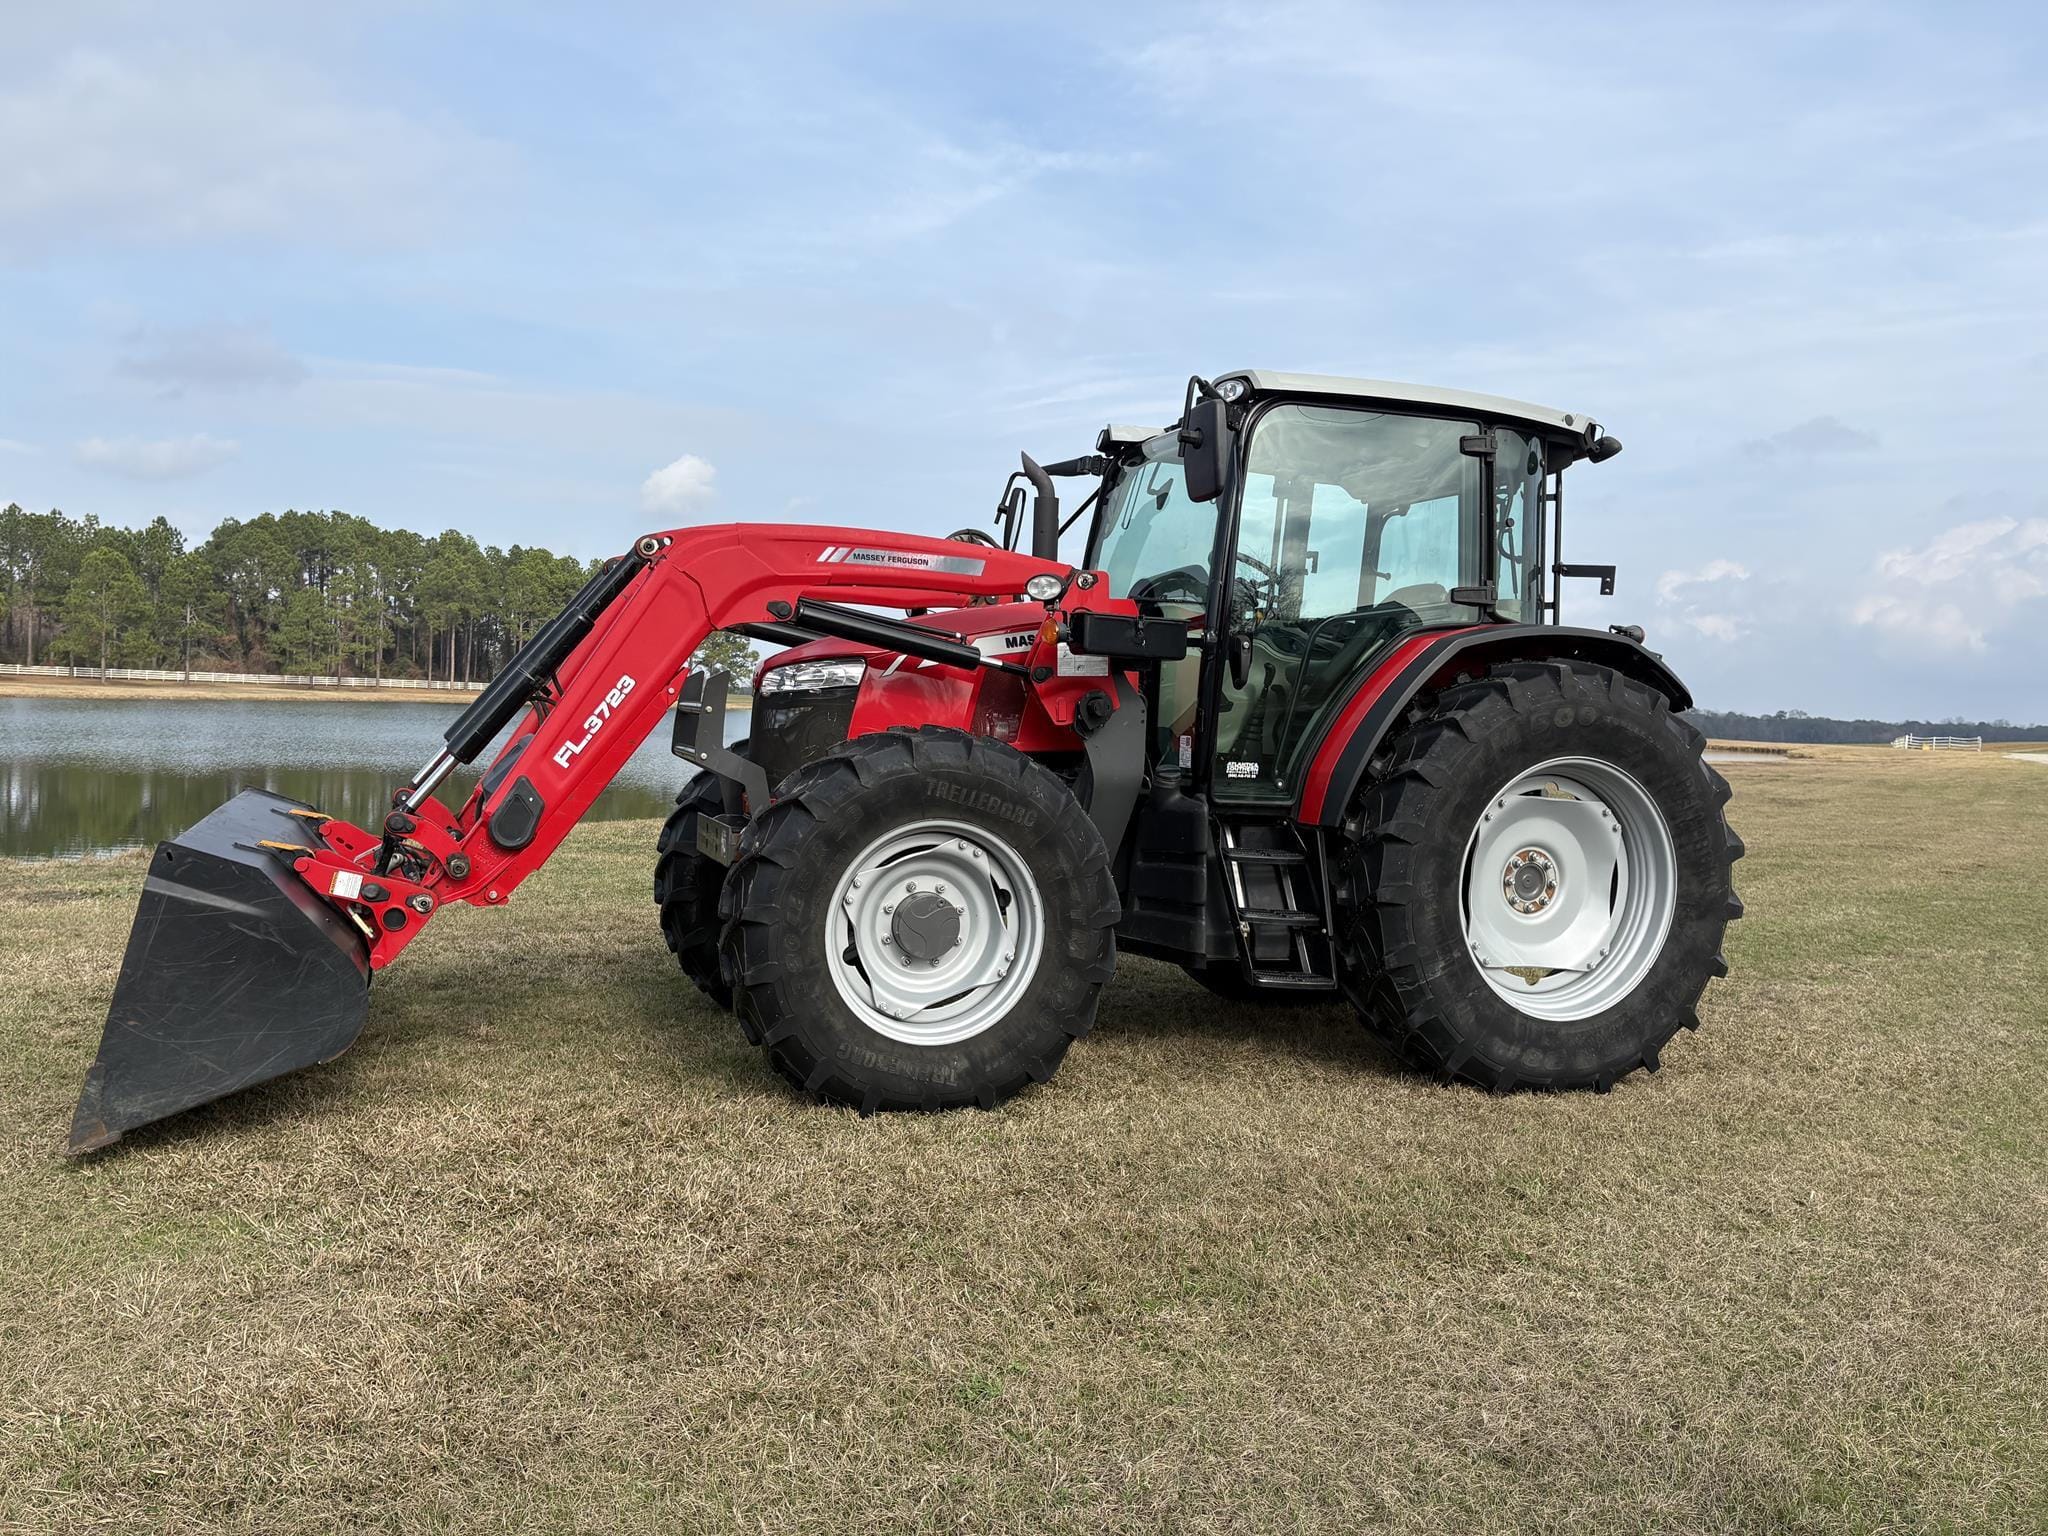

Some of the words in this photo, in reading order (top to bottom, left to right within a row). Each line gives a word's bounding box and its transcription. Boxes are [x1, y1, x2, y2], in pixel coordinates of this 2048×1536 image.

[853, 552, 886, 563] MASSEY
[887, 555, 929, 566] FERGUSON
[552, 674, 636, 769] FL.3723
[926, 777, 1038, 828] TRELLEBORG
